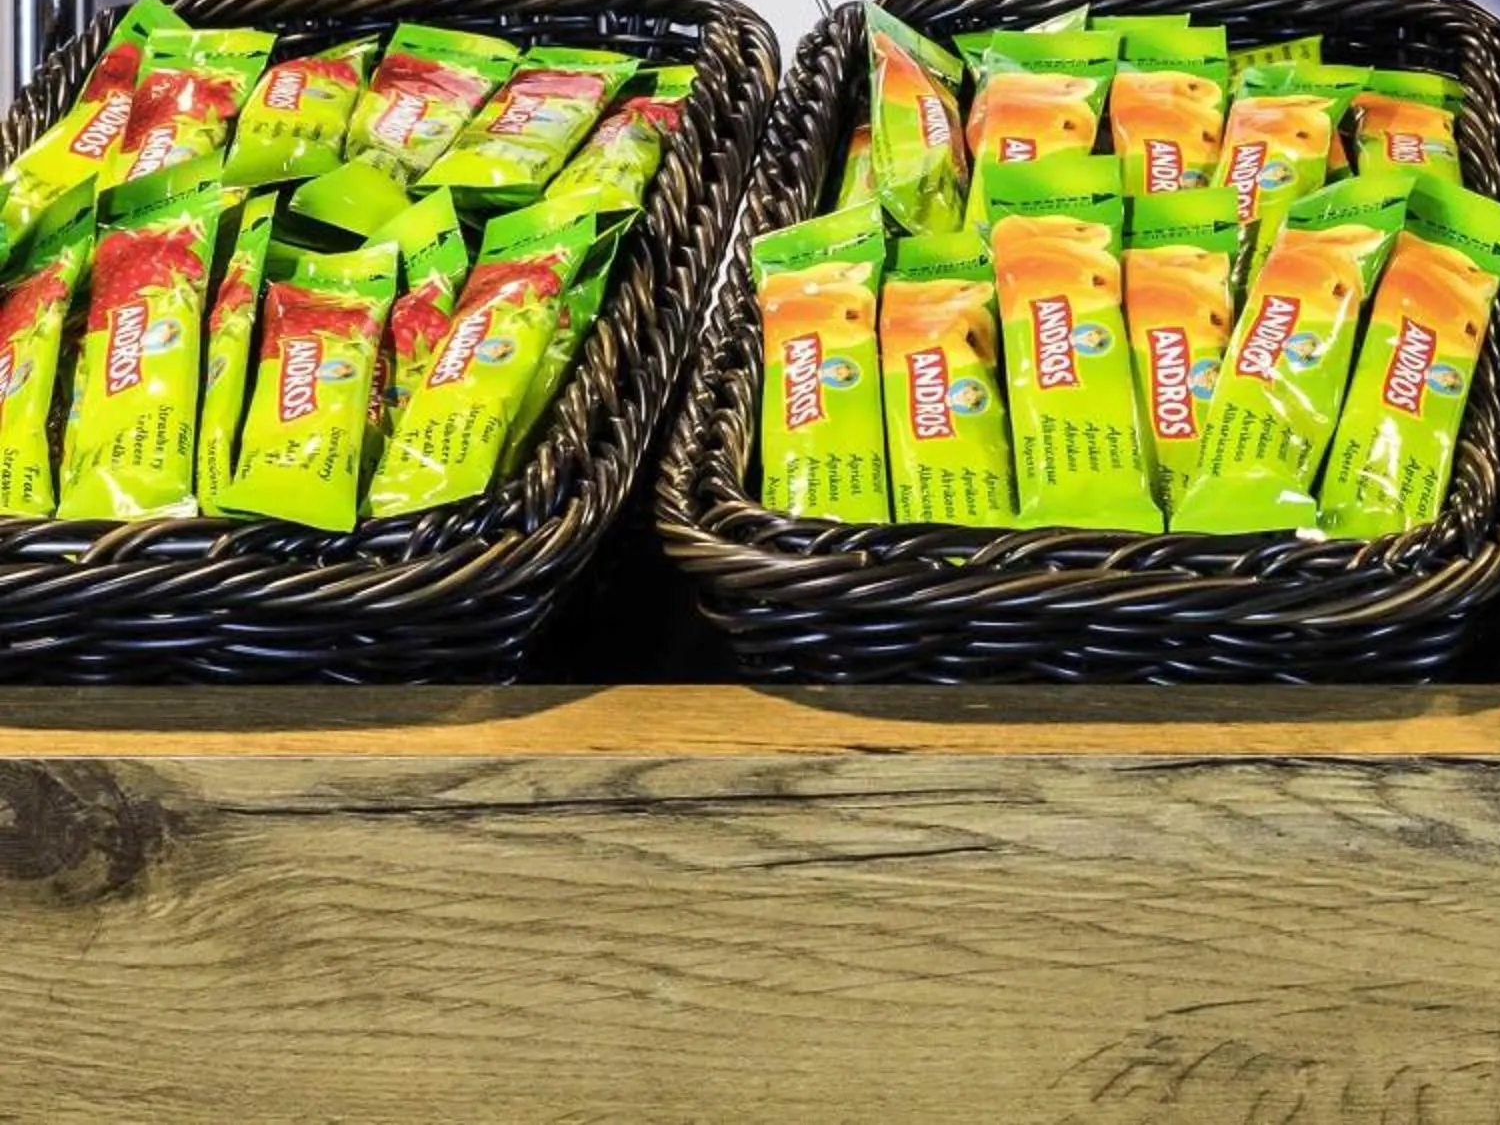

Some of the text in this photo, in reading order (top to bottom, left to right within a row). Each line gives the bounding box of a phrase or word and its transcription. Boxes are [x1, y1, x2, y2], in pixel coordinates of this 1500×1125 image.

[75, 91, 131, 157] ANDROS
[110, 306, 145, 392] ANDROS
[431, 313, 488, 386] ANDROS
[1036, 301, 1073, 386] ANDROS
[1239, 297, 1296, 377] ANDROS
[1386, 325, 1435, 412] ANDROS
[284, 339, 320, 420] ANDROS
[787, 339, 821, 425] ANDROS
[912, 353, 949, 437] ANDROS
[1152, 331, 1193, 438] ANDROS
